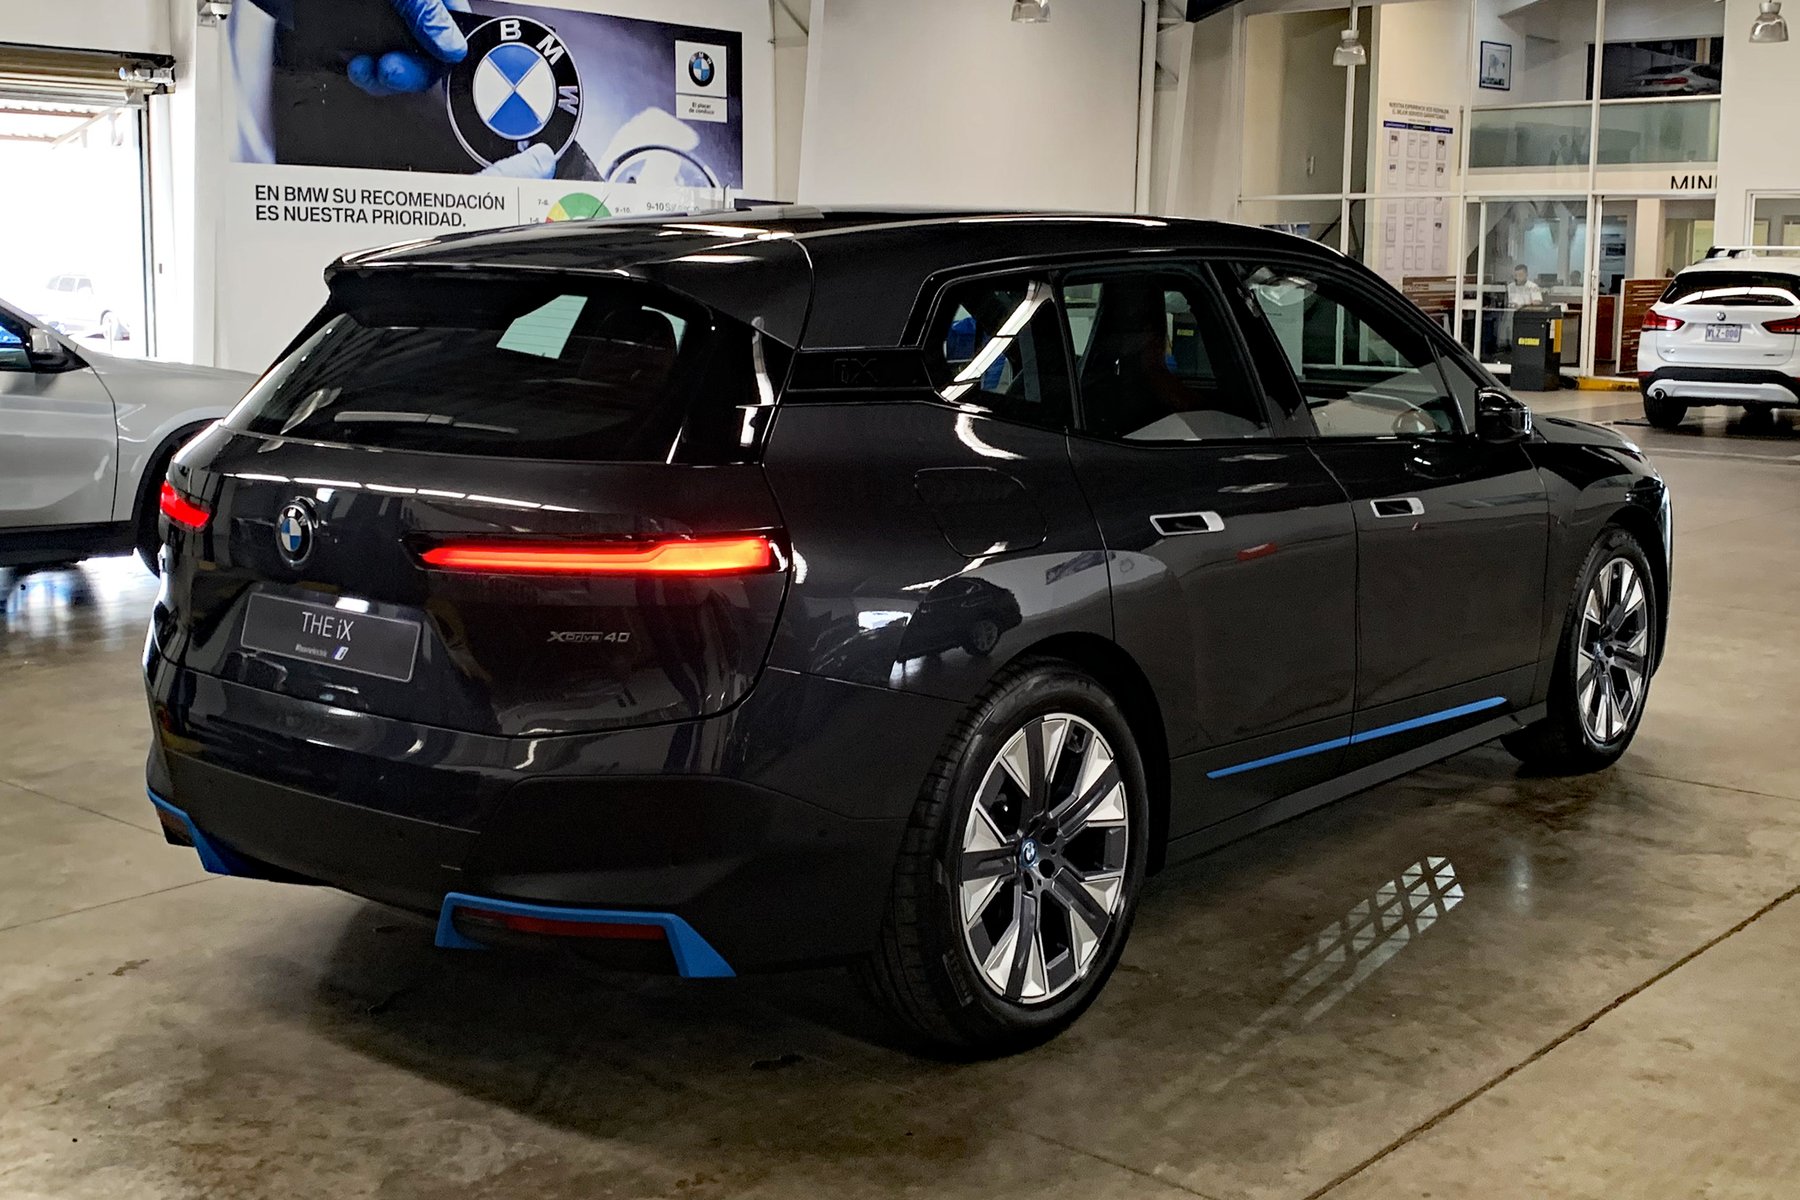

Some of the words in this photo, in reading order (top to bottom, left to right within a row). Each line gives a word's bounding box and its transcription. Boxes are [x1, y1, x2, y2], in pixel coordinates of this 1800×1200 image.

[500, 20, 579, 116] BMW
[255, 184, 279, 201] EN
[284, 186, 329, 203] BMW
[332, 187, 356, 204] SU
[361, 189, 505, 211] RECOMENDACIÓN
[255, 205, 279, 221] ES
[284, 205, 368, 224] NUESTRA
[372, 209, 466, 227] PRIORIDAD.
[302, 611, 335, 638] THE
[336, 619, 355, 642] iX
[604, 632, 631, 643] 40
